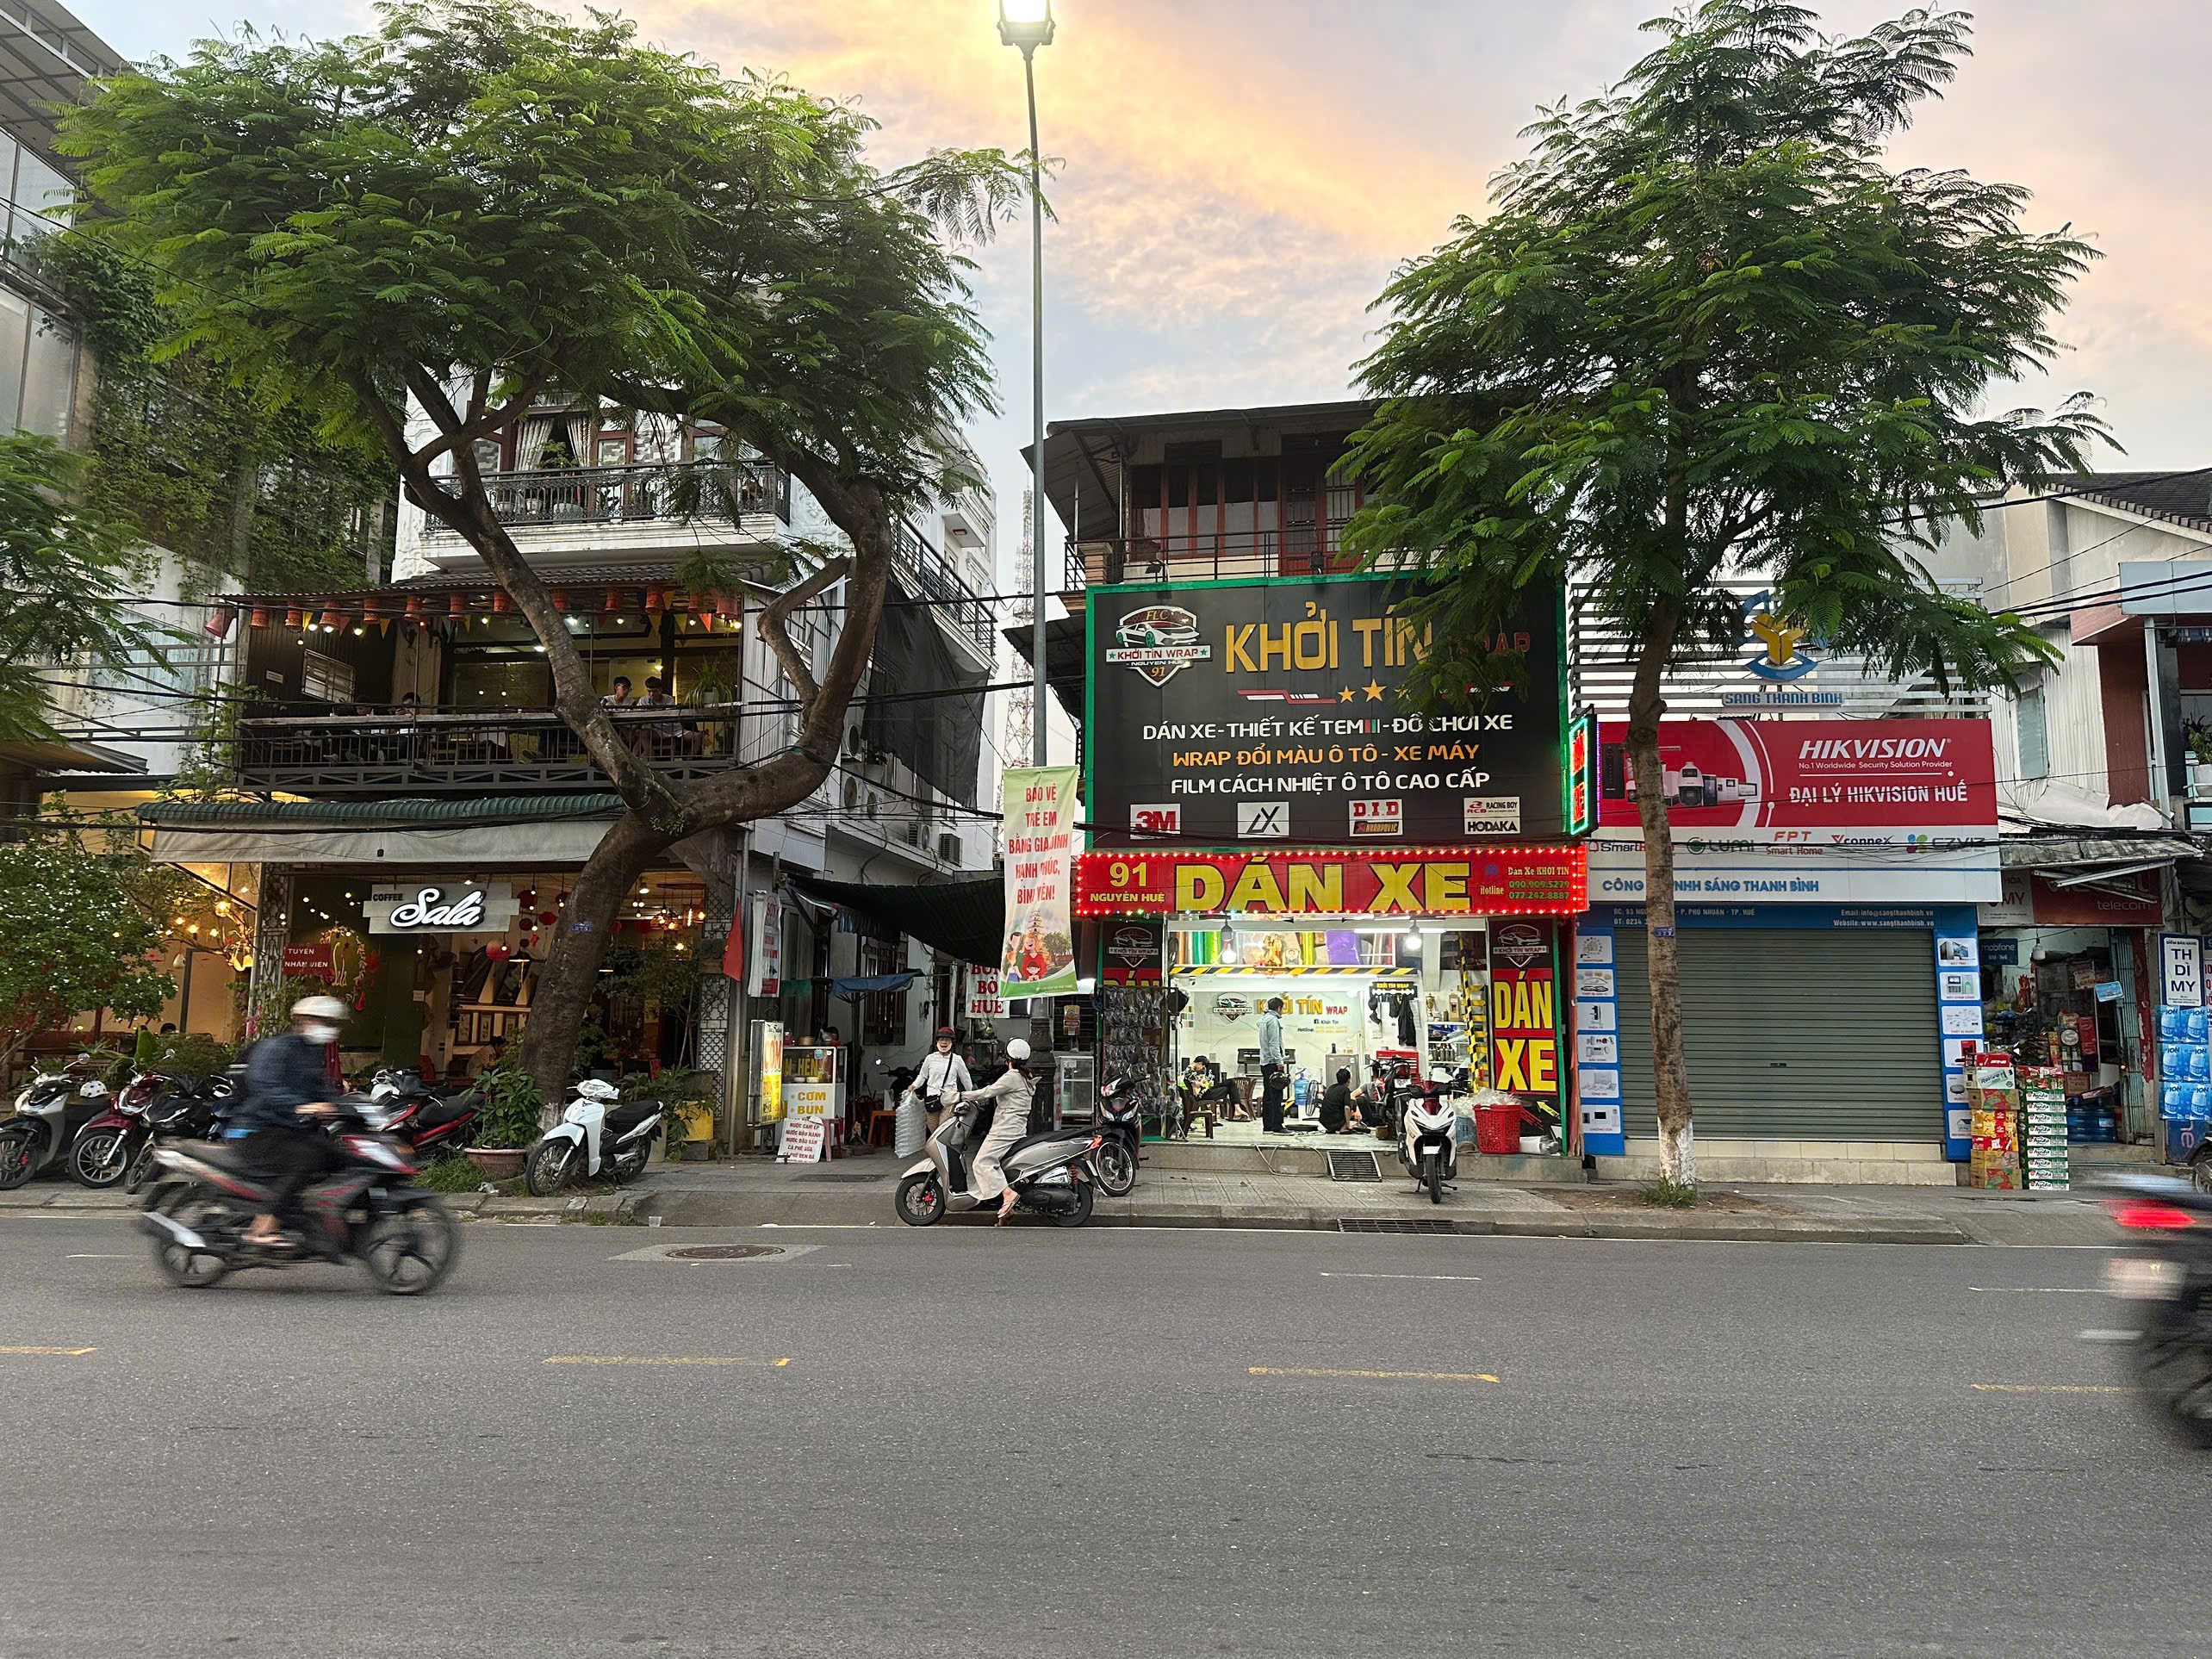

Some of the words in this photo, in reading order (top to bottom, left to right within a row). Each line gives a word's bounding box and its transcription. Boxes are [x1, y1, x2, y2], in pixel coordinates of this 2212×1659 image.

[1226, 601, 1339, 673] KHỞI
[1117, 649, 1142, 660] KHỞI
[1166, 649, 1199, 658] WRAP
[1151, 667, 1165, 677] 91
[1766, 693, 1808, 704] THANH
[1143, 721, 1185, 740] DÁN
[1289, 714, 1320, 736] KẾ
[1320, 719, 1364, 735] TEM
[1428, 715, 1479, 732] CHƠI
[1484, 714, 1513, 730] XE
[1172, 750, 1231, 767] WRAP
[1236, 743, 1271, 766] ĐỔI
[1277, 744, 1323, 765] MÀU
[1328, 743, 1344, 763] Ô
[1348, 743, 1377, 762] TÔ
[1393, 745, 1421, 761] XE
[1427, 739, 1480, 761] MÁY
[1799, 738, 1946, 760] HIKVISION
[1858, 761, 1889, 770] Security
[1171, 779, 1215, 794] FILM
[1219, 774, 1273, 793] CÁCH
[1277, 772, 1337, 795] NHIỆT
[1341, 771, 1357, 791] Ô
[1361, 770, 1391, 791] TÔ
[1395, 774, 1440, 789] CAO
[1445, 766, 1490, 788] CẤP
[1025, 782, 1043, 802] BẢO
[1046, 783, 1057, 805] VỆ
[1789, 786, 1817, 807] ĐẠI
[1823, 782, 1842, 803] LÝ
[1848, 786, 1929, 803] HIKVISION
[1935, 779, 1968, 802] HUẾ
[1025, 807, 1040, 828] TRẺ
[1043, 811, 1057, 827] EM
[1135, 811, 1177, 831] 3M
[1468, 820, 1518, 832] HODAKA
[1009, 833, 1032, 854] BẰNG
[1034, 837, 1049, 853] GIA
[1774, 831, 1812, 842] FPT
[1766, 847, 1793, 855] Smart
[1797, 847, 1824, 855] Home
[1109, 862, 1147, 887] 91
[1175, 856, 1345, 912] DÁN
[1368, 863, 1472, 912] XE
[1602, 877, 1643, 892] CÔNG
[1705, 877, 1740, 892] SÁNG
[1743, 880, 1785, 892] THANH
[1790, 876, 1819, 892] BÌNH
[372, 893, 403, 902] COFFEE
[2097, 899, 2151, 911] telecom
[2171, 948, 2192, 960] TH
[2174, 962, 2190, 976] DÌ
[977, 976, 998, 994] BÒ
[2171, 980, 2196, 992] MY
[1296, 994, 1323, 1015] TÍN
[1326, 1006, 1348, 1015] WRAP
[1494, 970, 1553, 1029] DÁN
[1494, 1039, 1556, 1091] XE
[797, 1090, 827, 1101] CƠM
[797, 1102, 824, 1115] BÚN
